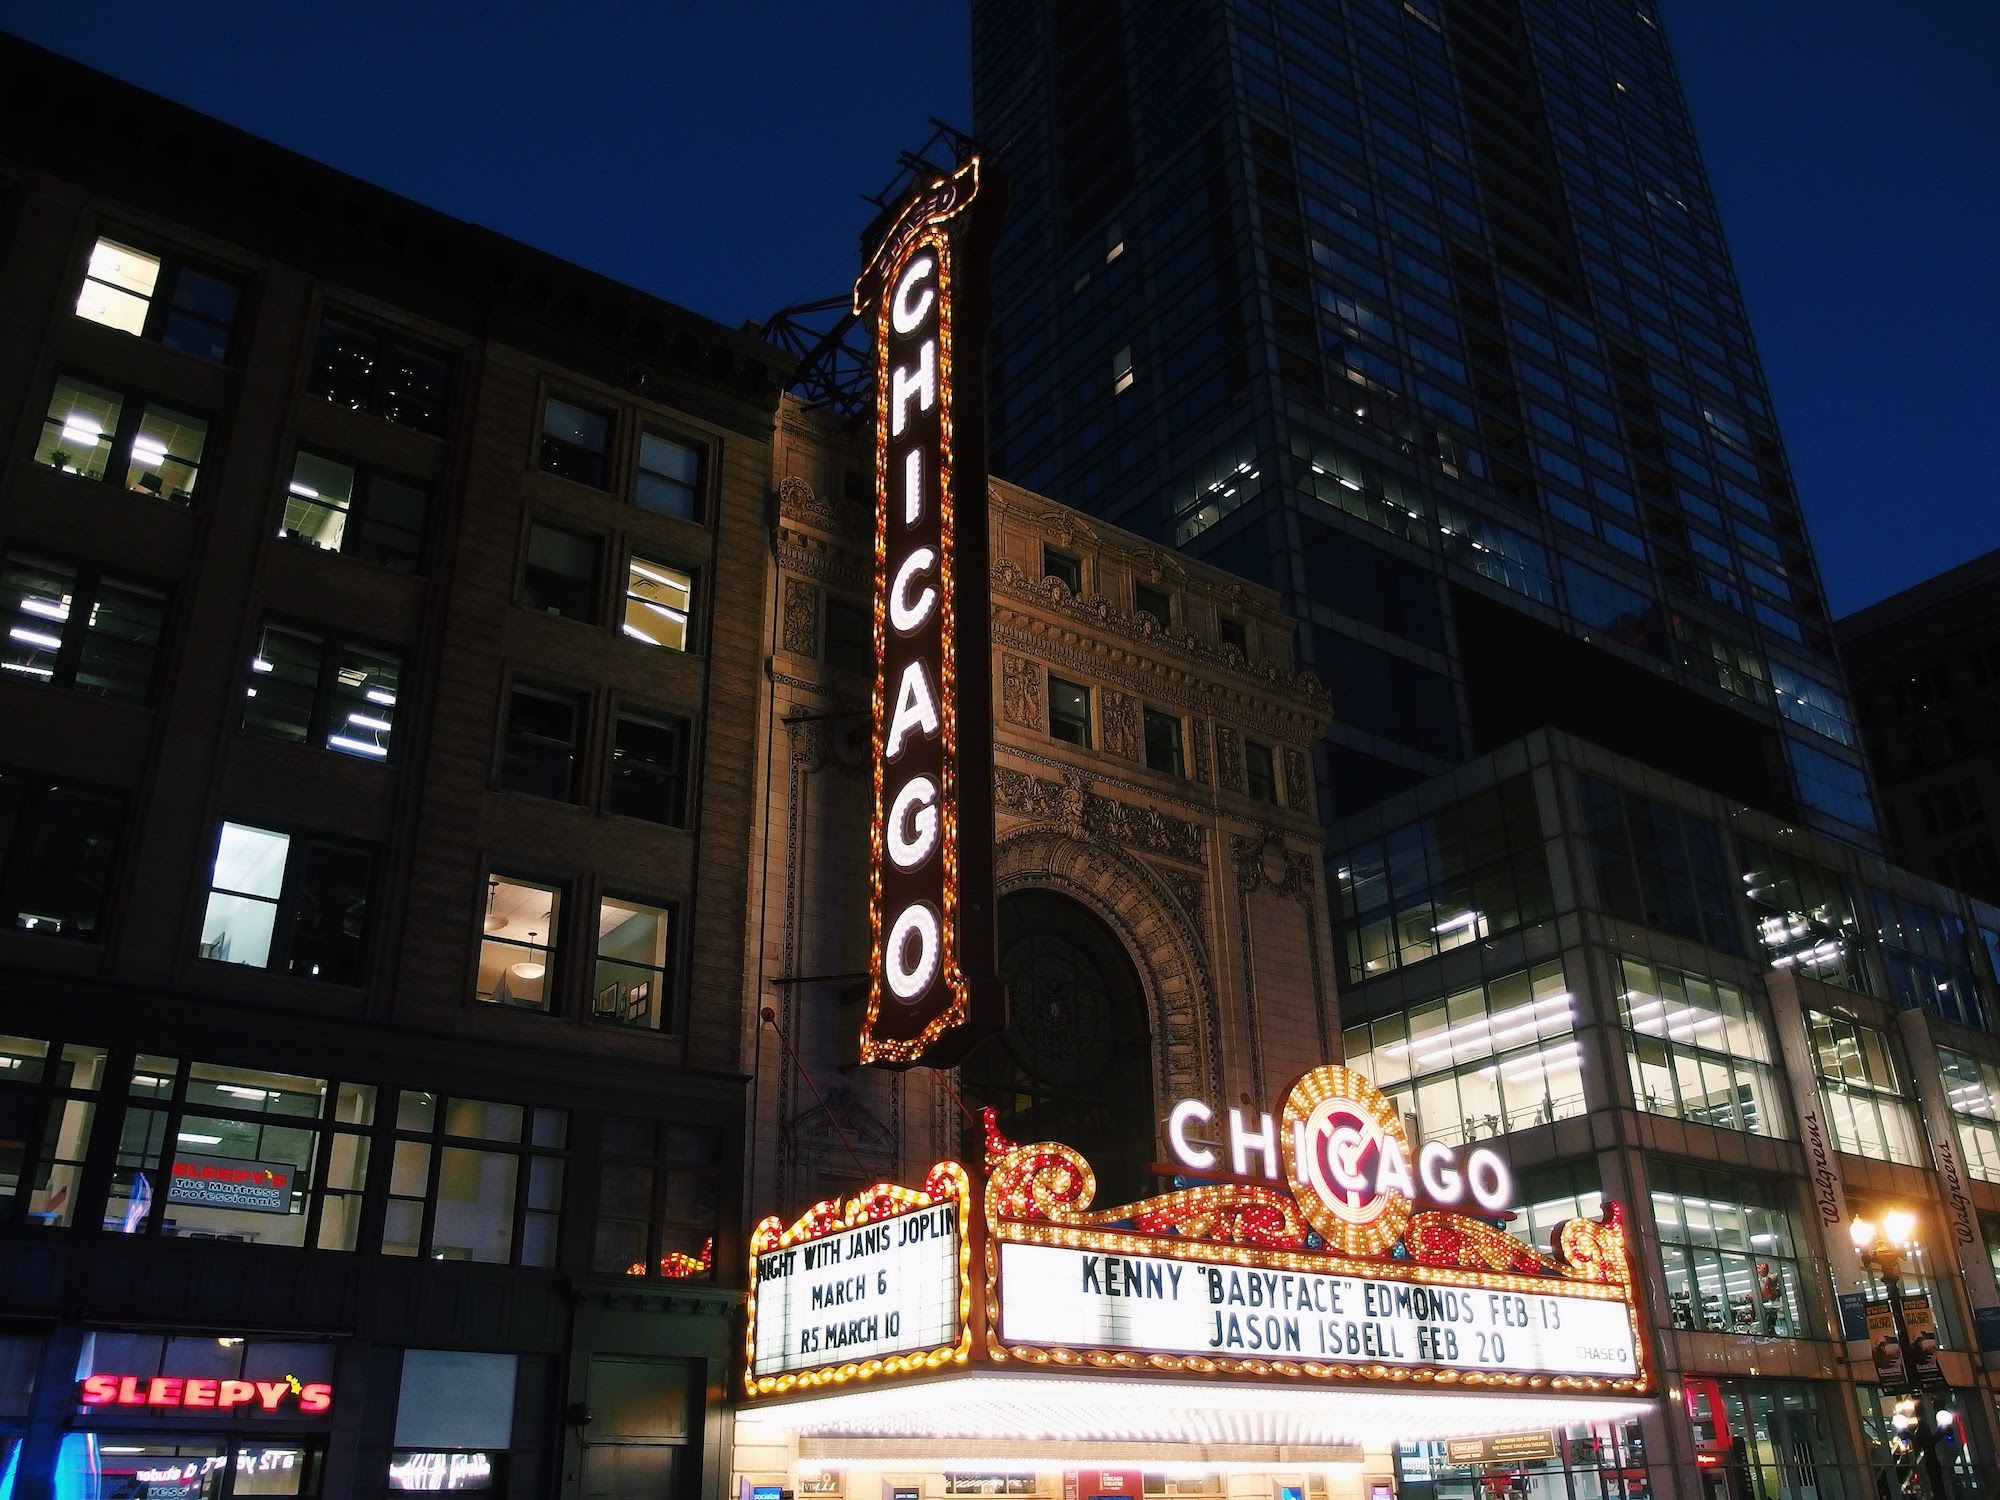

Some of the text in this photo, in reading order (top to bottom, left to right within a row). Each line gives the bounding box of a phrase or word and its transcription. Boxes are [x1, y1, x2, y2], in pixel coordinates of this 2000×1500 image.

[885, 257, 939, 1000] CHICAGO
[1169, 1098, 1512, 1210] CHICAGO
[1804, 1110, 1840, 1228] Walgreens
[170, 1187, 281, 1208] Professionals
[175, 1178, 280, 1198] The Mattress
[1938, 1139, 1974, 1247] Walgreens
[757, 1206, 958, 1283] NIGHT WITH JANIS JOPLIN
[812, 1269, 888, 1311] MARCH 6
[1082, 1255, 1561, 1330] KENNY "BABYFACE" EDMONDS FEB 13
[825, 1314, 879, 1350] MARCH
[885, 1310, 901, 1338] 10
[1208, 1310, 1506, 1363] JASON ISBELL FEB 20
[1576, 1346, 1616, 1361] CHASE
[82, 1373, 333, 1412] SLEEPY'S
